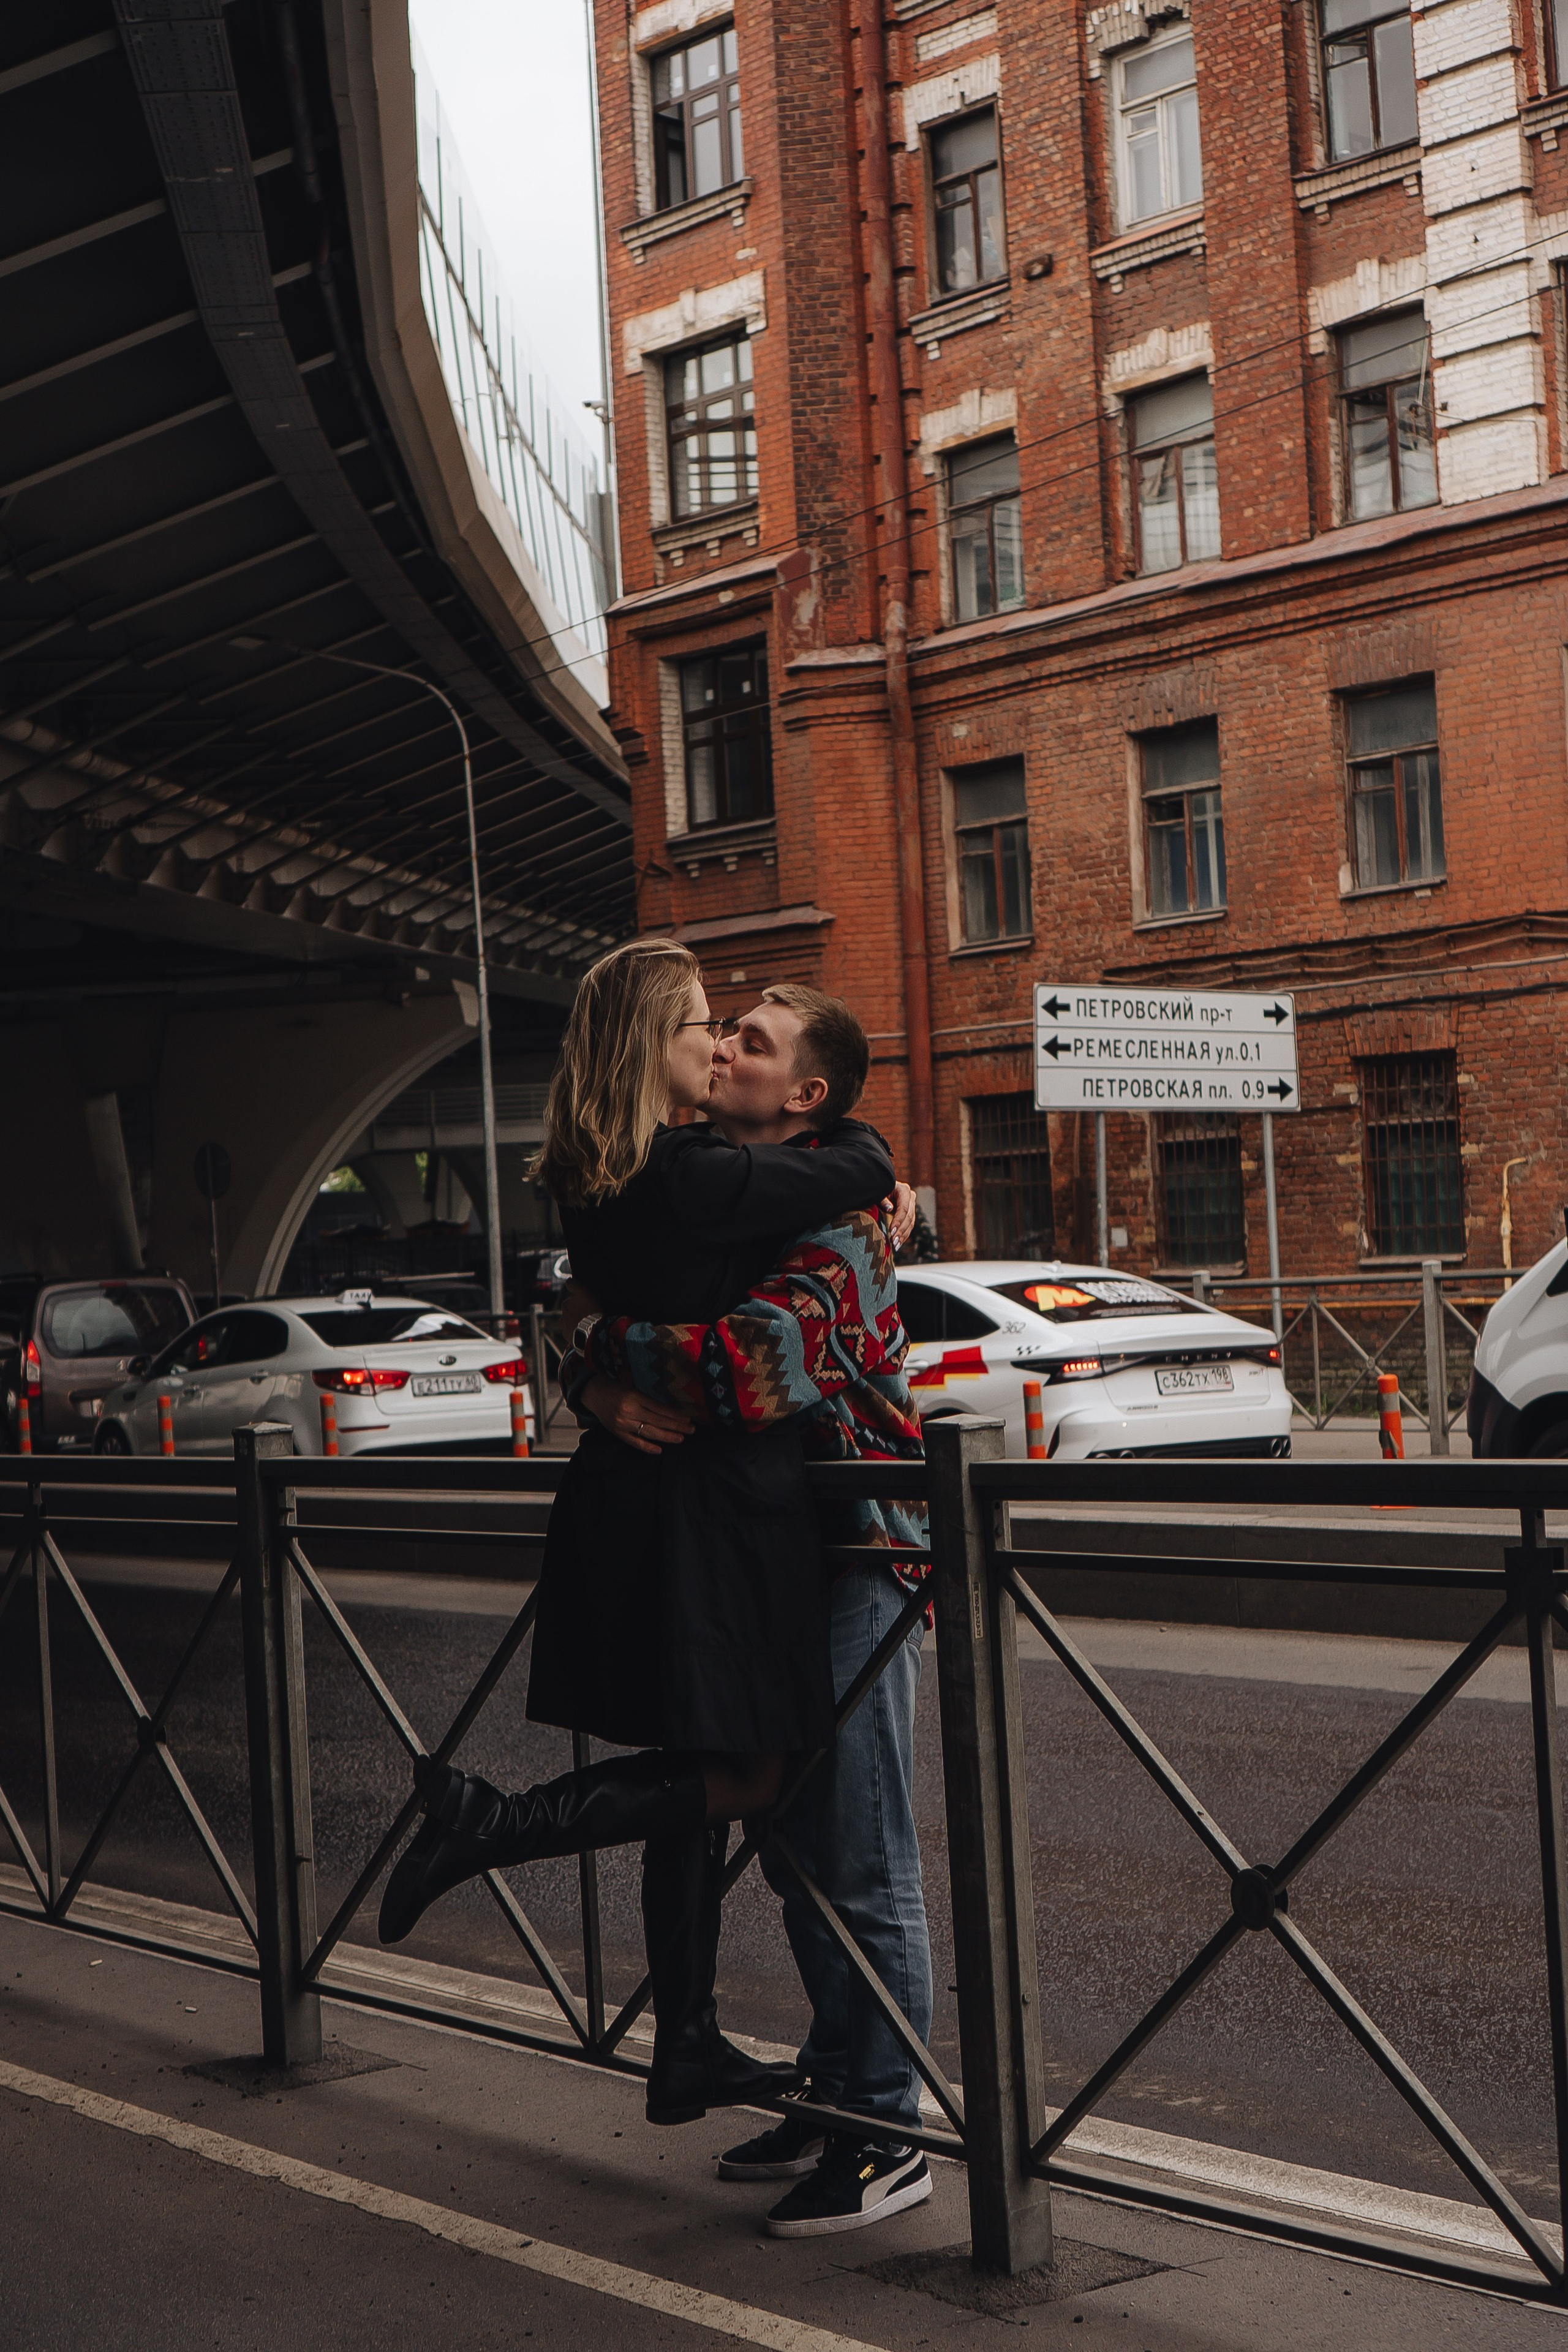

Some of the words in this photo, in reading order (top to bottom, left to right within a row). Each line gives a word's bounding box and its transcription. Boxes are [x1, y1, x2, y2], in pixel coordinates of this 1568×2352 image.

[1076, 995, 1194, 1020] ПЕТРОВСКИЙ
[1200, 1008, 1232, 1026] пр-т
[1074, 1038, 1210, 1060] РЕМЕСЛЕННАЯ
[1083, 1078, 1202, 1098] ПЕТРОВСКАЯ
[1208, 1085, 1232, 1099] пл.
[1002, 1321, 1027, 1334] 362
